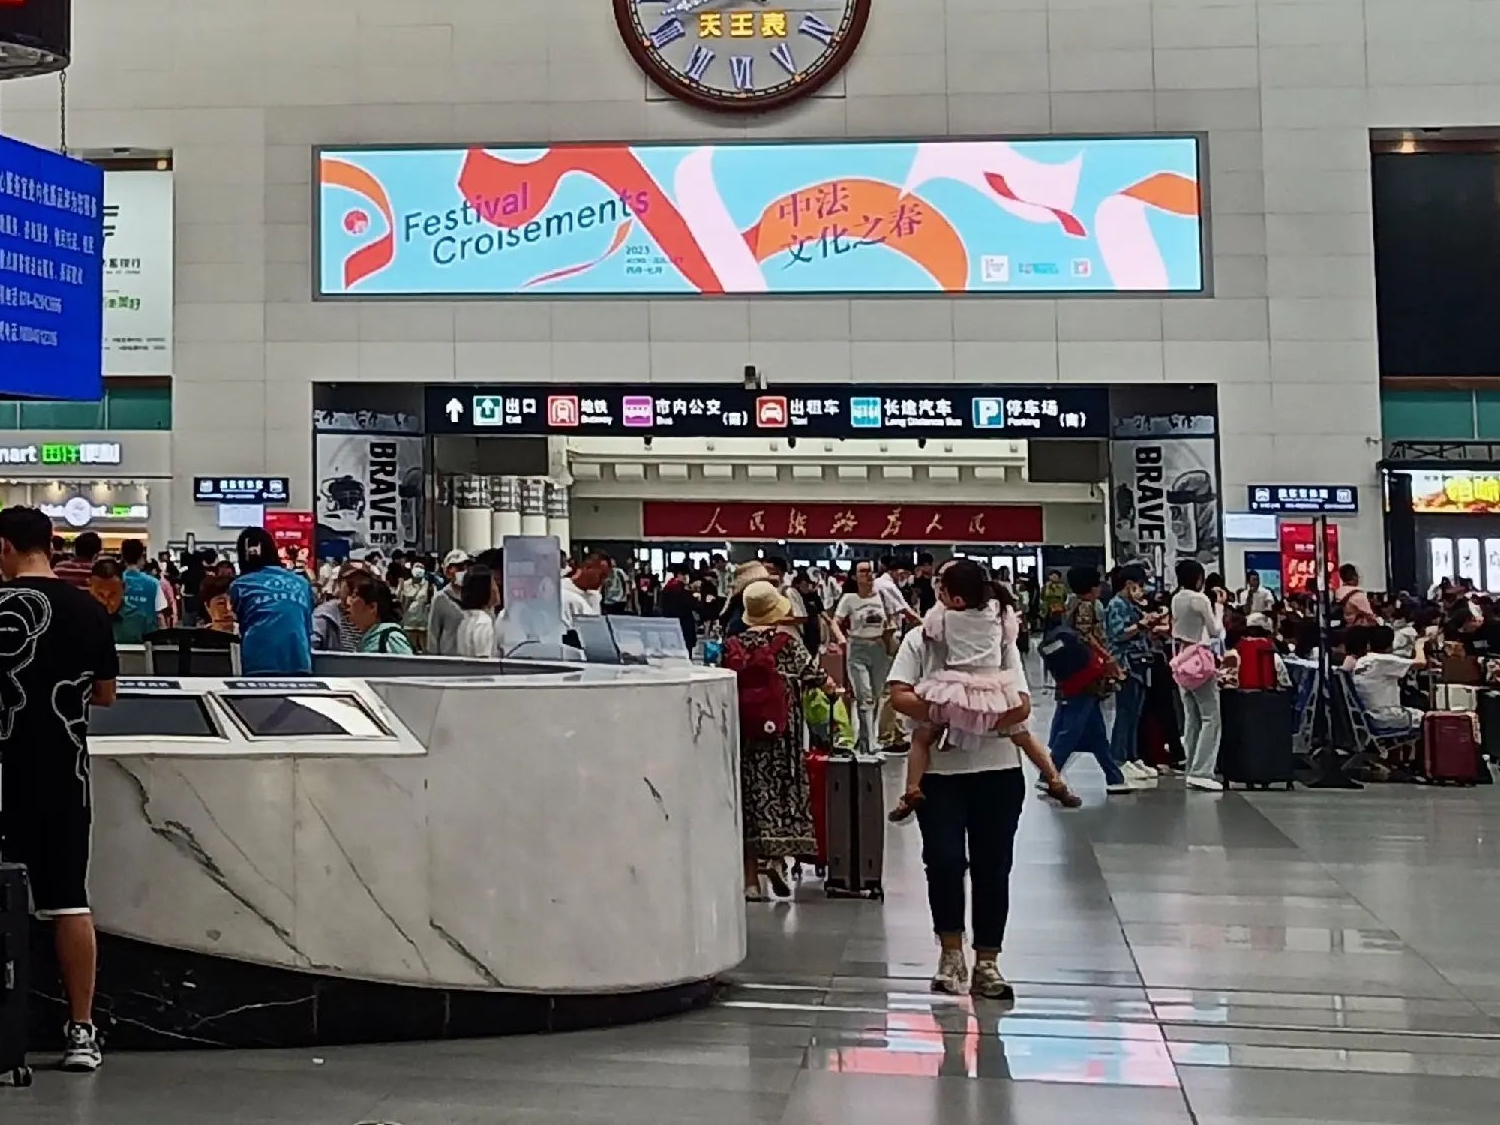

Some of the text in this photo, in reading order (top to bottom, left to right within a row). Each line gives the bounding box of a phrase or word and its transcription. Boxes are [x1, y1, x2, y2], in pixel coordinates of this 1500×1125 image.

[699, 13, 787, 37] 天王表
[404, 182, 528, 242] Festival
[778, 182, 850, 228] 中法
[433, 189, 649, 265] Croisements
[780, 203, 924, 271] 文化之春
[505, 398, 536, 413] 出口
[581, 399, 608, 414] 地铁
[655, 398, 721, 415] 市内公交
[790, 399, 840, 416] 出租车
[884, 399, 952, 416] 长途汽车
[1006, 399, 1058, 416] 停车场
[370, 442, 396, 530] BRAVE
[1135, 446, 1165, 540] BRAVE
